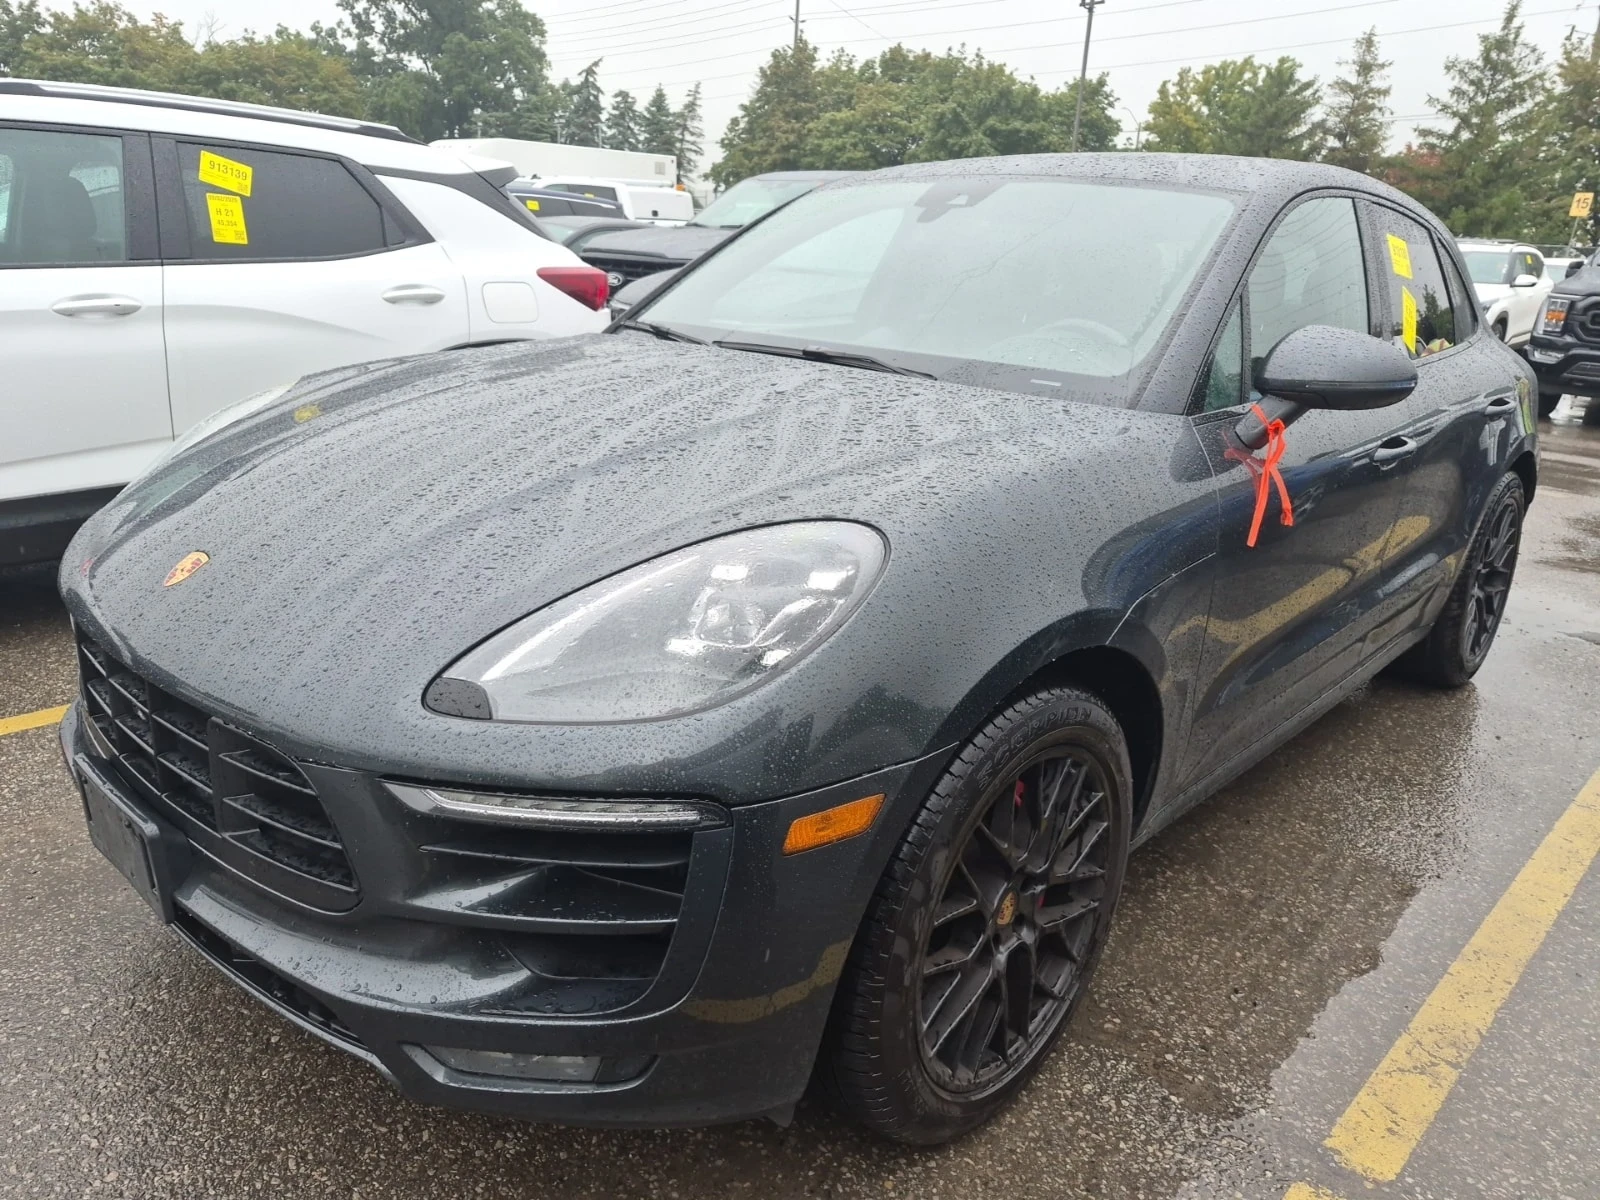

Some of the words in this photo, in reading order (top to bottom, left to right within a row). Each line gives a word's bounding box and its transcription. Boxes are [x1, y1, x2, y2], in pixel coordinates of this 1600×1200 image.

[209, 160, 248, 181] 913139
[1576, 197, 1590, 209] 15
[216, 208, 222, 216] H
[225, 208, 234, 217] 21
